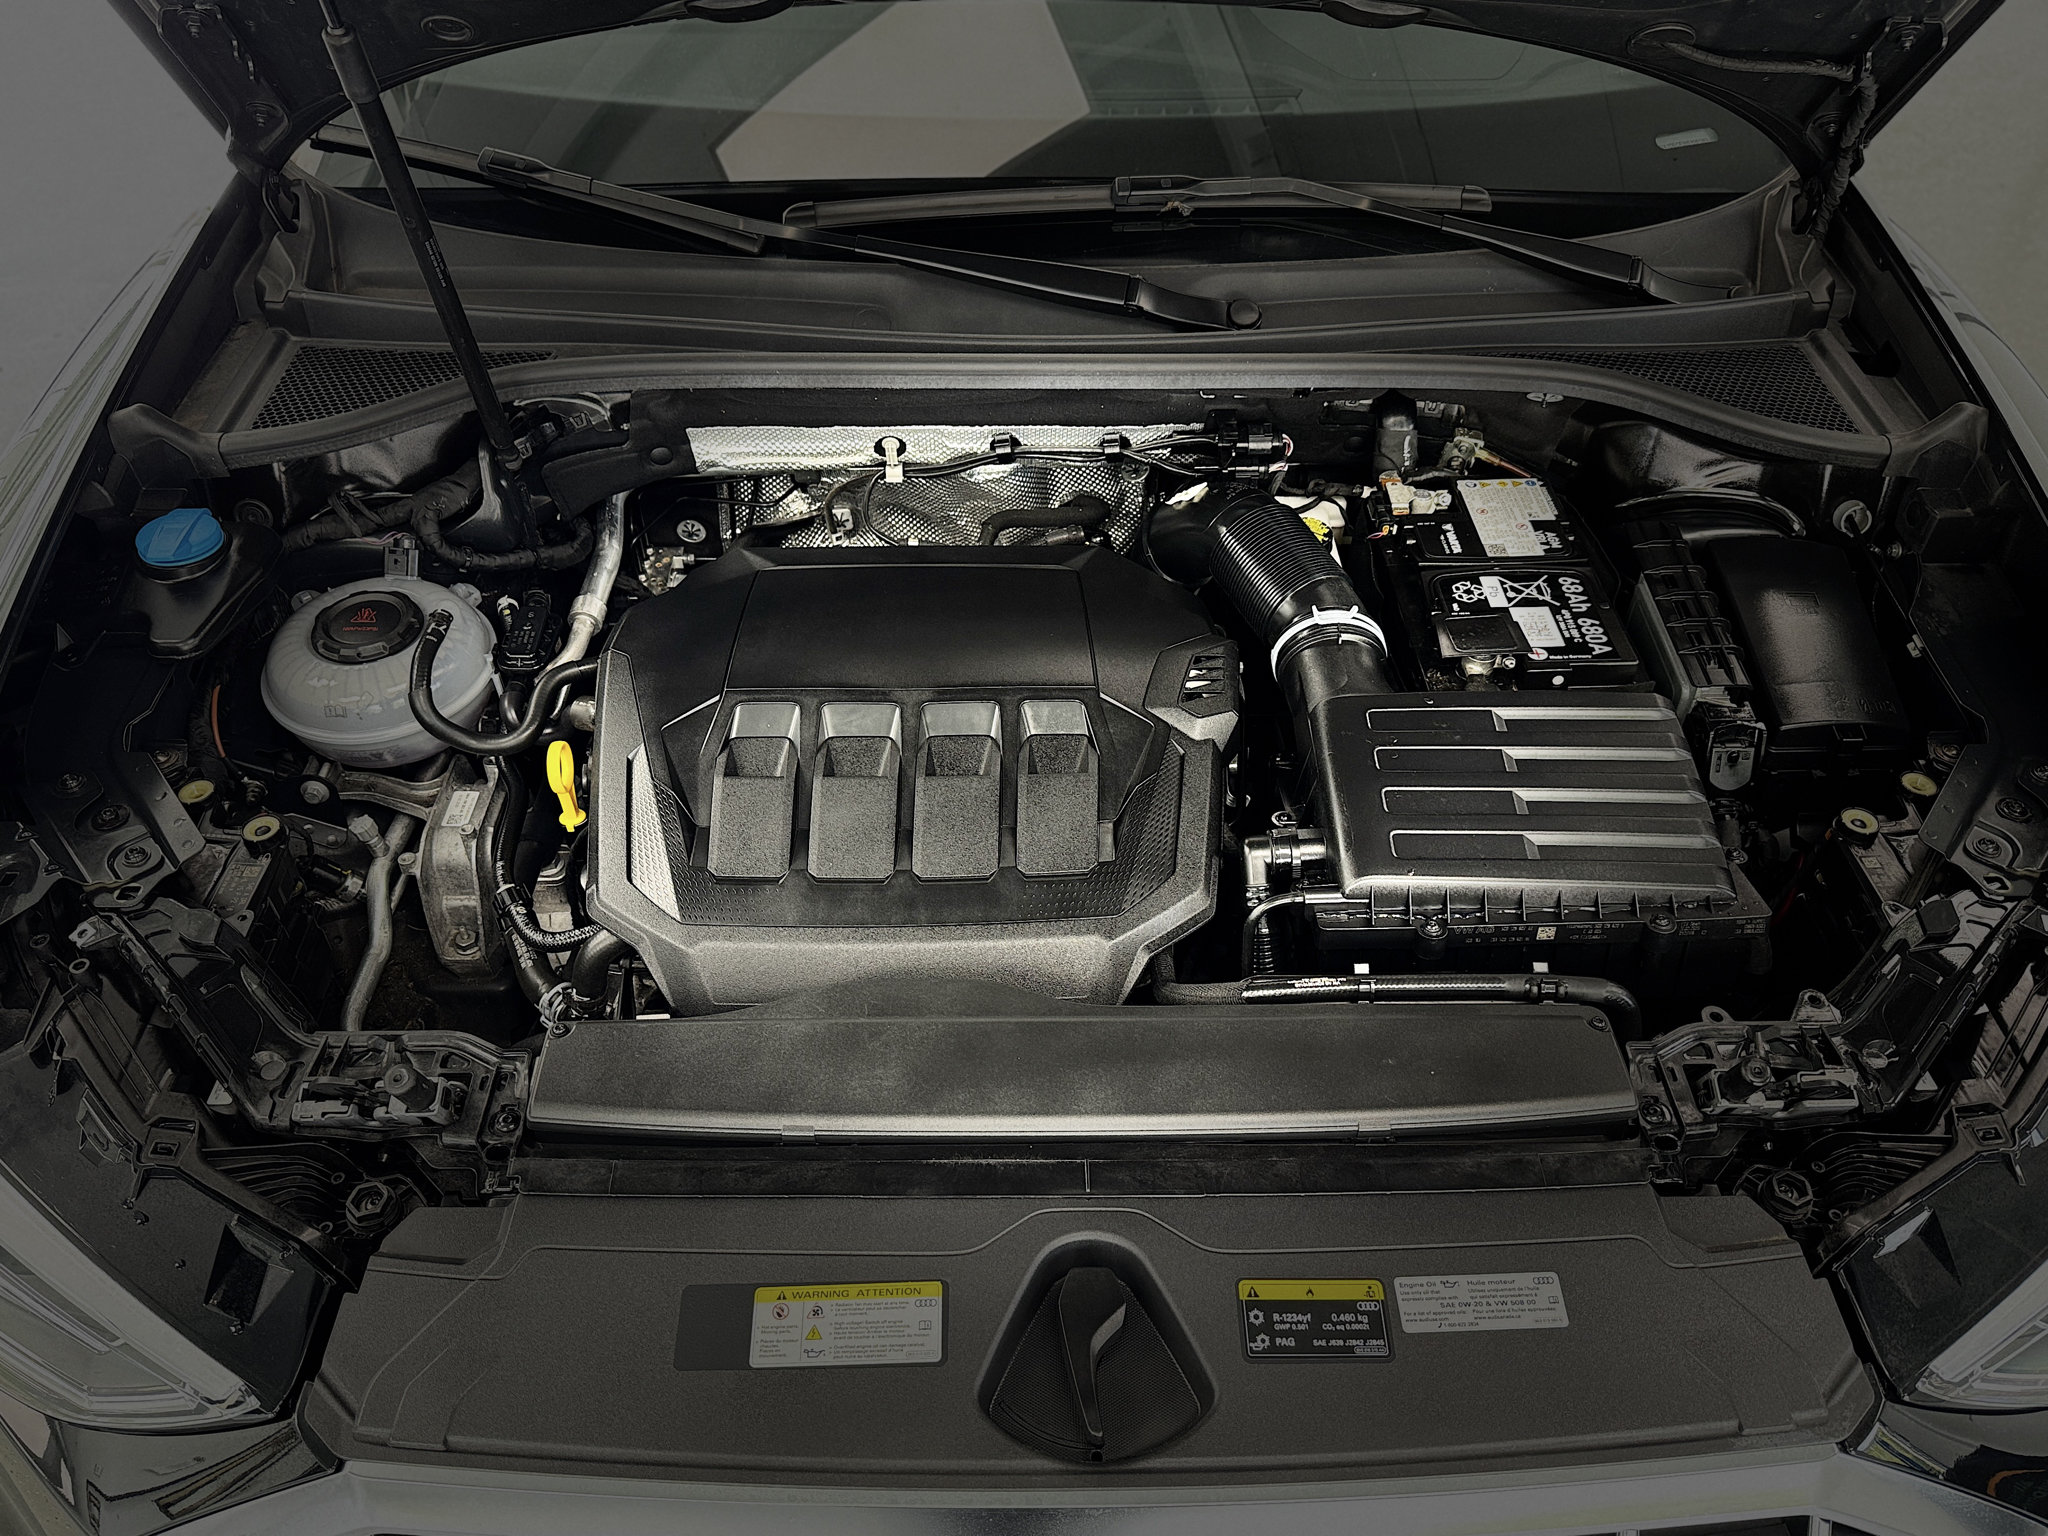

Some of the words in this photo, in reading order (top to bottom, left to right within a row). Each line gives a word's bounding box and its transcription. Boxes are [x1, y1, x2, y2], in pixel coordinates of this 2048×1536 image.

[1487, 586, 1499, 597] Pb
[1558, 576, 1592, 612] 68Ah
[1577, 618, 1612, 655] 680A
[792, 1290, 849, 1299] WARNING
[856, 1287, 922, 1297] ATTENTION
[1273, 1313, 1311, 1323] R-1234yf
[1357, 1313, 1368, 1323] kg
[1275, 1338, 1296, 1347] PAG
